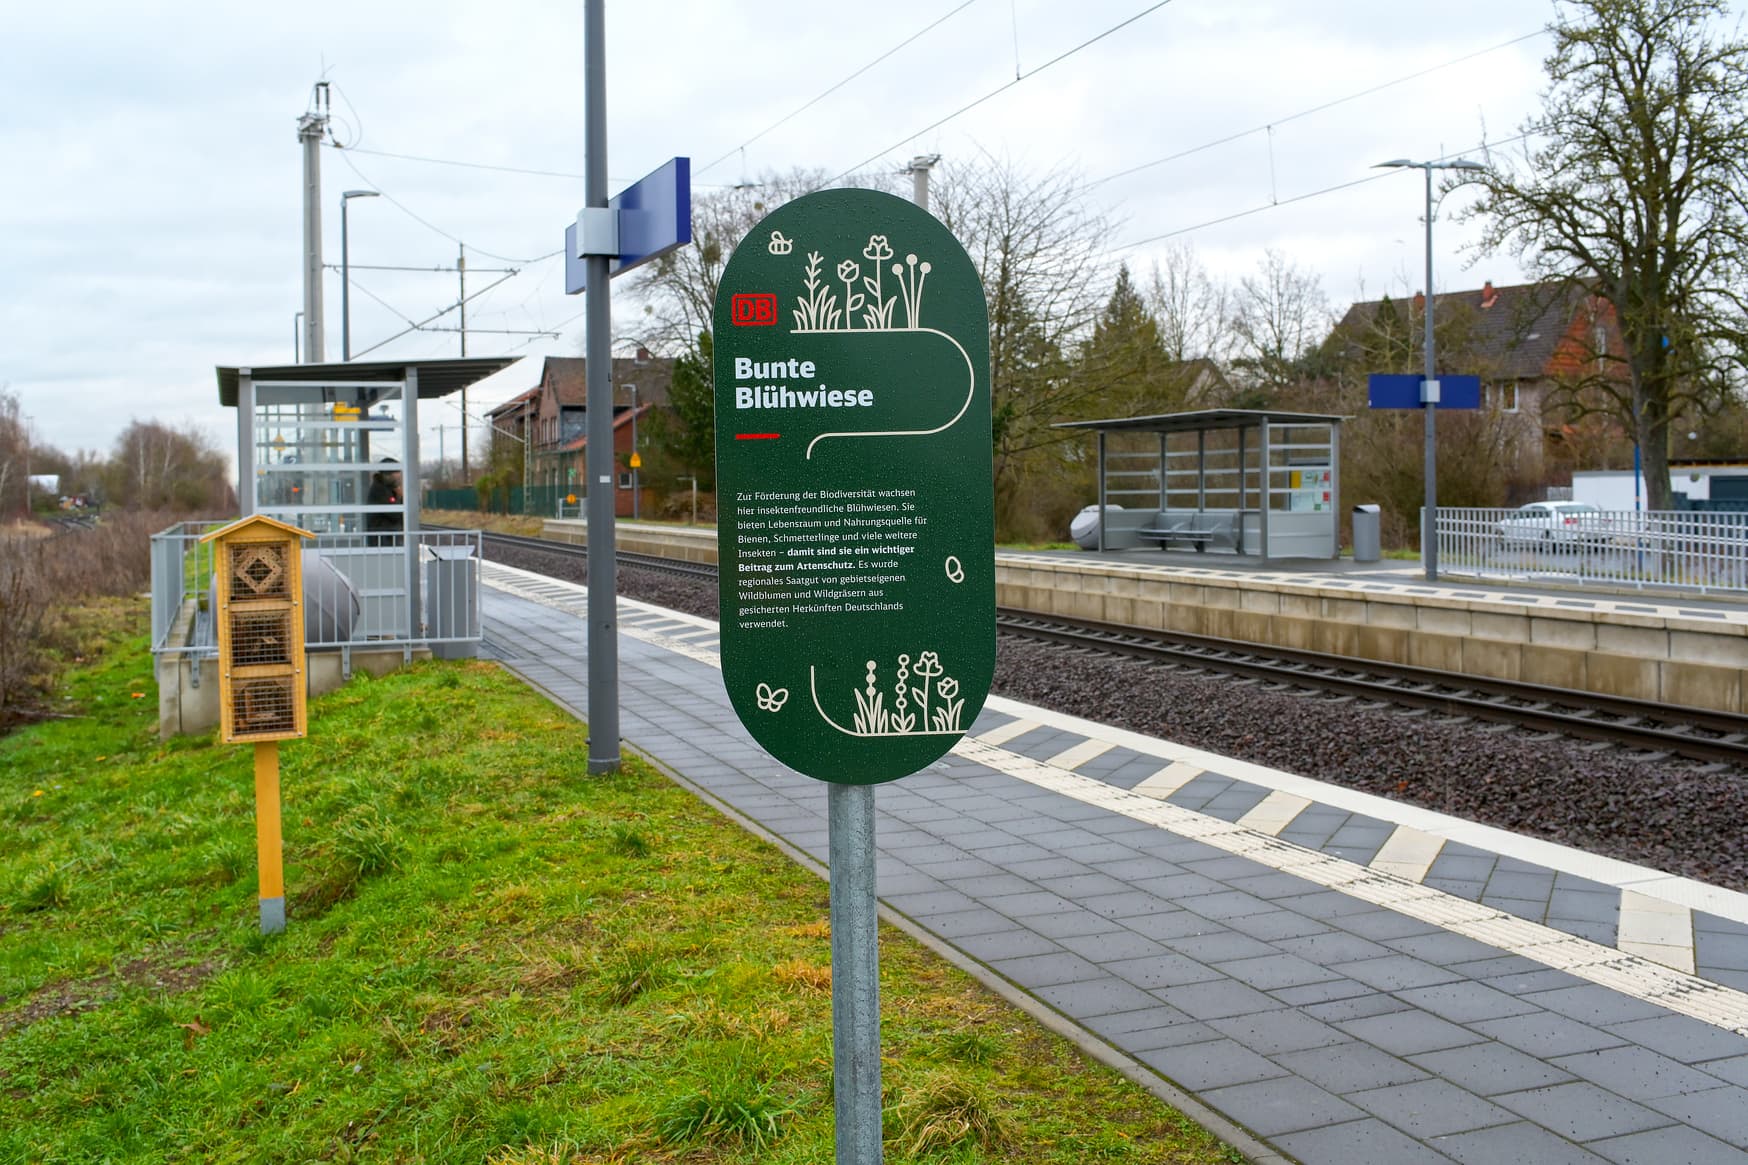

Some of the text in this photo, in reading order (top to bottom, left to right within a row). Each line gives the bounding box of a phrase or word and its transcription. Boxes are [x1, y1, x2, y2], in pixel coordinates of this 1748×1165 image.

[737, 299, 773, 321] DB
[735, 357, 816, 380] Bunte
[735, 384, 874, 409] Blühwiese
[737, 488, 916, 501] Zur Förderung der Biodiversität wachsen
[737, 502, 915, 515] hier insektenfreundliche Blühwiesen. Sie
[737, 516, 927, 530] bieten Lebensraum und Nahrungsquelle für
[738, 530, 918, 544] Bienen, Schmetterlinge und viele weitere
[738, 549, 776, 558] Insekten
[787, 548, 814, 556] damit
[816, 547, 837, 556] sind
[838, 546, 852, 555] sie
[854, 546, 870, 555] ein
[871, 544, 915, 555] wichtiger
[738, 559, 899, 573] Beitrag zum Artenschutz. Es wurde
[738, 578, 784, 588] regionales
[786, 576, 819, 586] Saatgut
[840, 574, 906, 585] gebietseigenen
[738, 589, 884, 601] Wildblumen und Wildgräsern aus
[739, 602, 904, 617] gesicherten Herkünften Deutschlands
[739, 620, 789, 629] verwendet.
